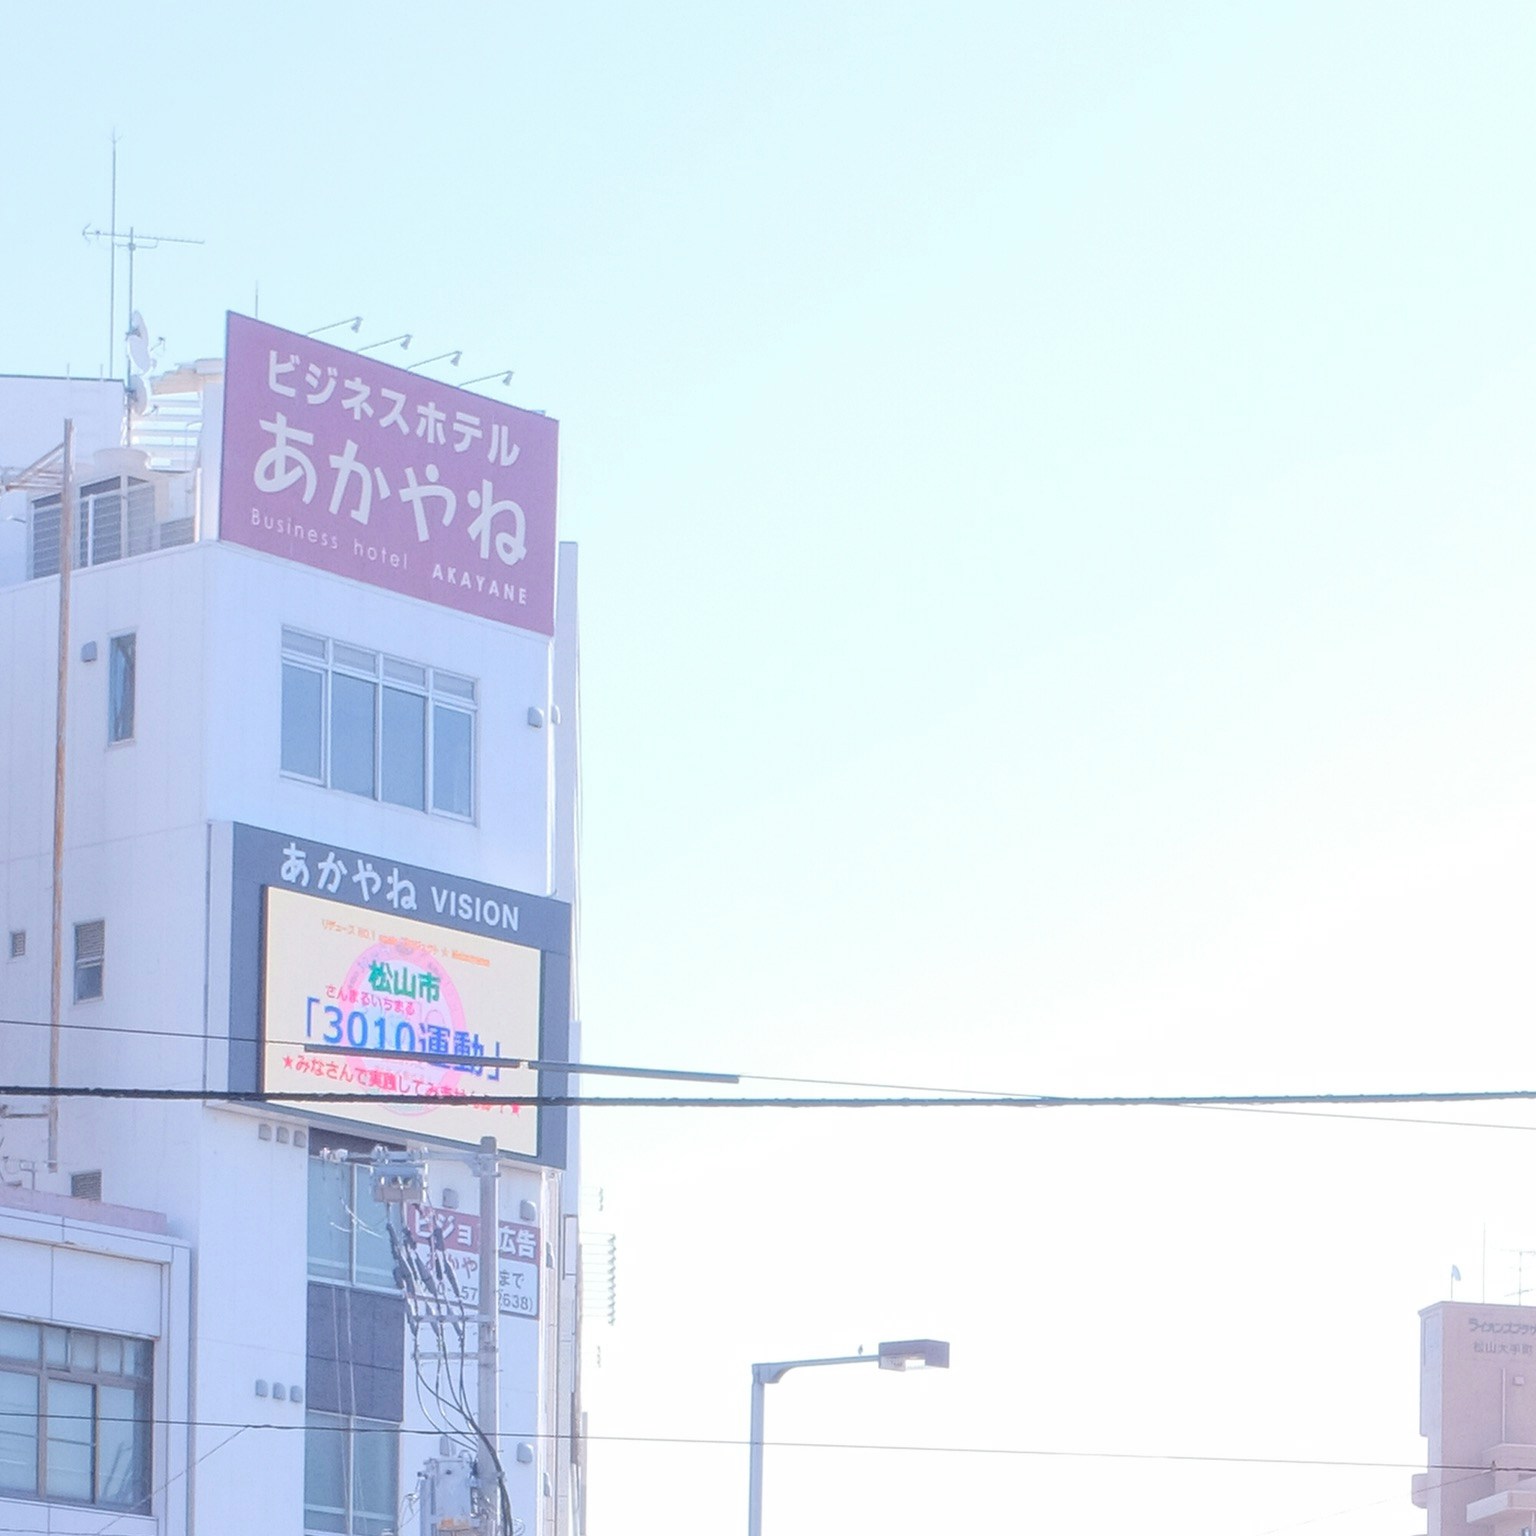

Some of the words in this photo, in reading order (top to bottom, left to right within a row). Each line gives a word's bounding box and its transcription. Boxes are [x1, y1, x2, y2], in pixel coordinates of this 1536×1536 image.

[267, 349, 521, 467] ビジネスホテル
[253, 411, 528, 567] あかやね
[250, 508, 339, 550] Business
[353, 538, 409, 571] hotel
[431, 563, 528, 606] AKAYANE
[280, 841, 418, 911] あかやね
[431, 885, 520, 933] VISION
[367, 959, 441, 1004] 松山市
[415, 1209, 537, 1259] ビジョ広告
